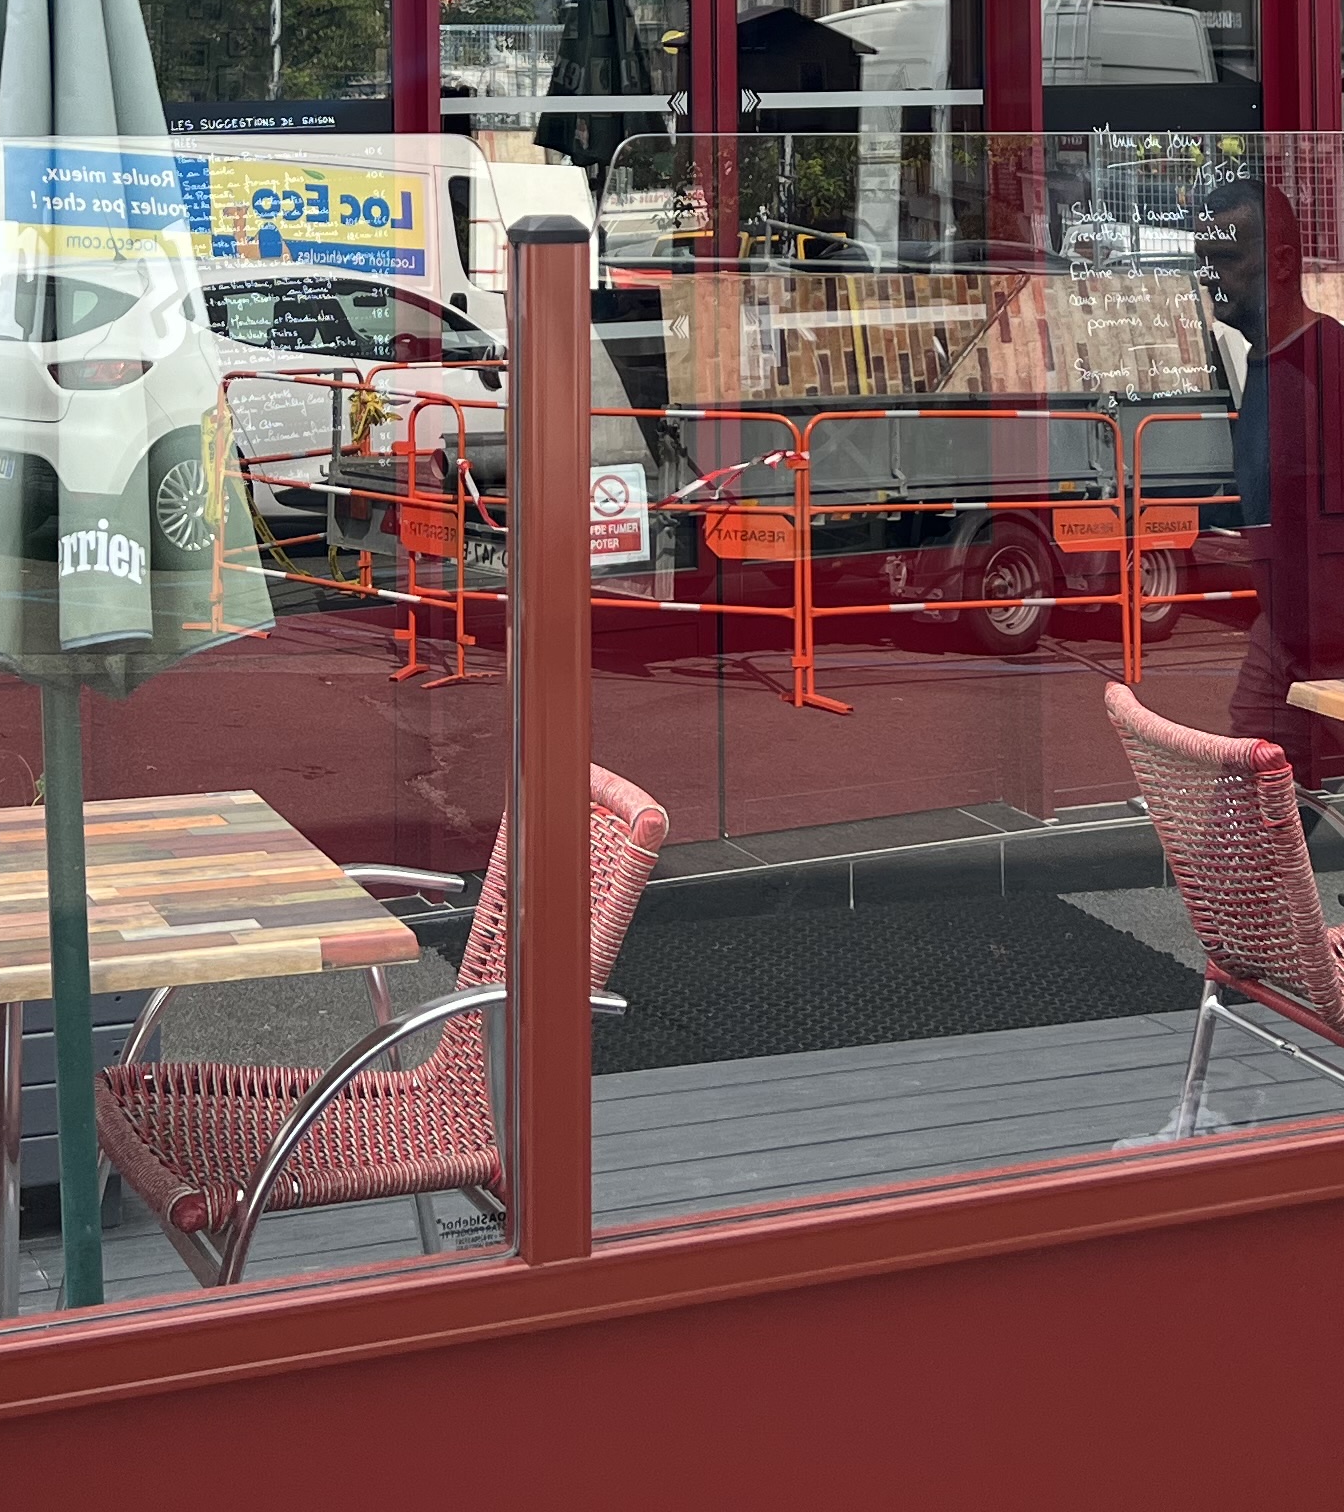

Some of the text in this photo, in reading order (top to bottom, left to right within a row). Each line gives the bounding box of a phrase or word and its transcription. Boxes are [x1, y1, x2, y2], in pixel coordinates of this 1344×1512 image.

[170, 119, 195, 131] LES
[1093, 123, 1138, 151] Menu
[1070, 199, 1117, 224] Salade
[1198, 203, 1215, 222] et
[608, 522, 639, 534] FUMER
